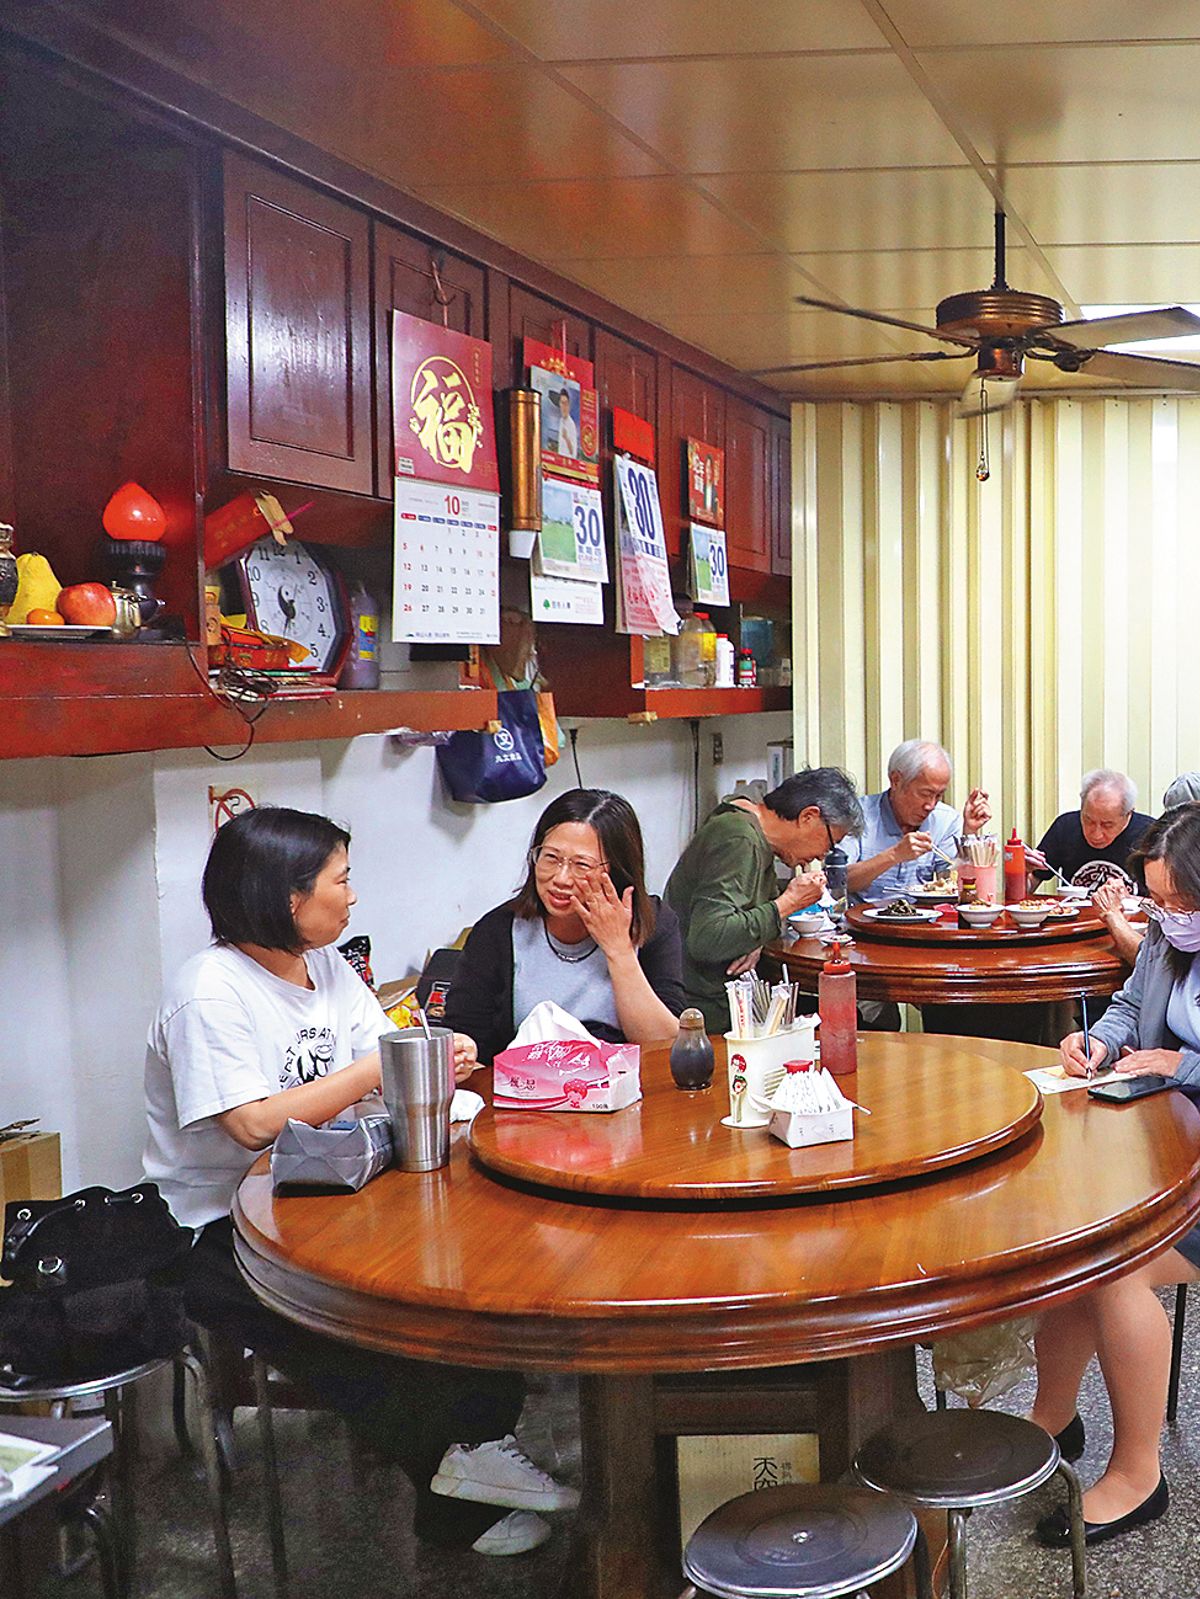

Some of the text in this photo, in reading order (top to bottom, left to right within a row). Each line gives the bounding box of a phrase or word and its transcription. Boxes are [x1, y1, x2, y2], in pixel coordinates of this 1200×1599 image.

[444, 494, 460, 515] 10
[628, 467, 655, 540] 30
[574, 505, 600, 547] 30
[709, 544, 725, 577] 30
[307, 570, 317, 585] 2
[317, 597, 326, 612] 3
[318, 623, 326, 637] 4
[310, 643, 319, 657] 5
